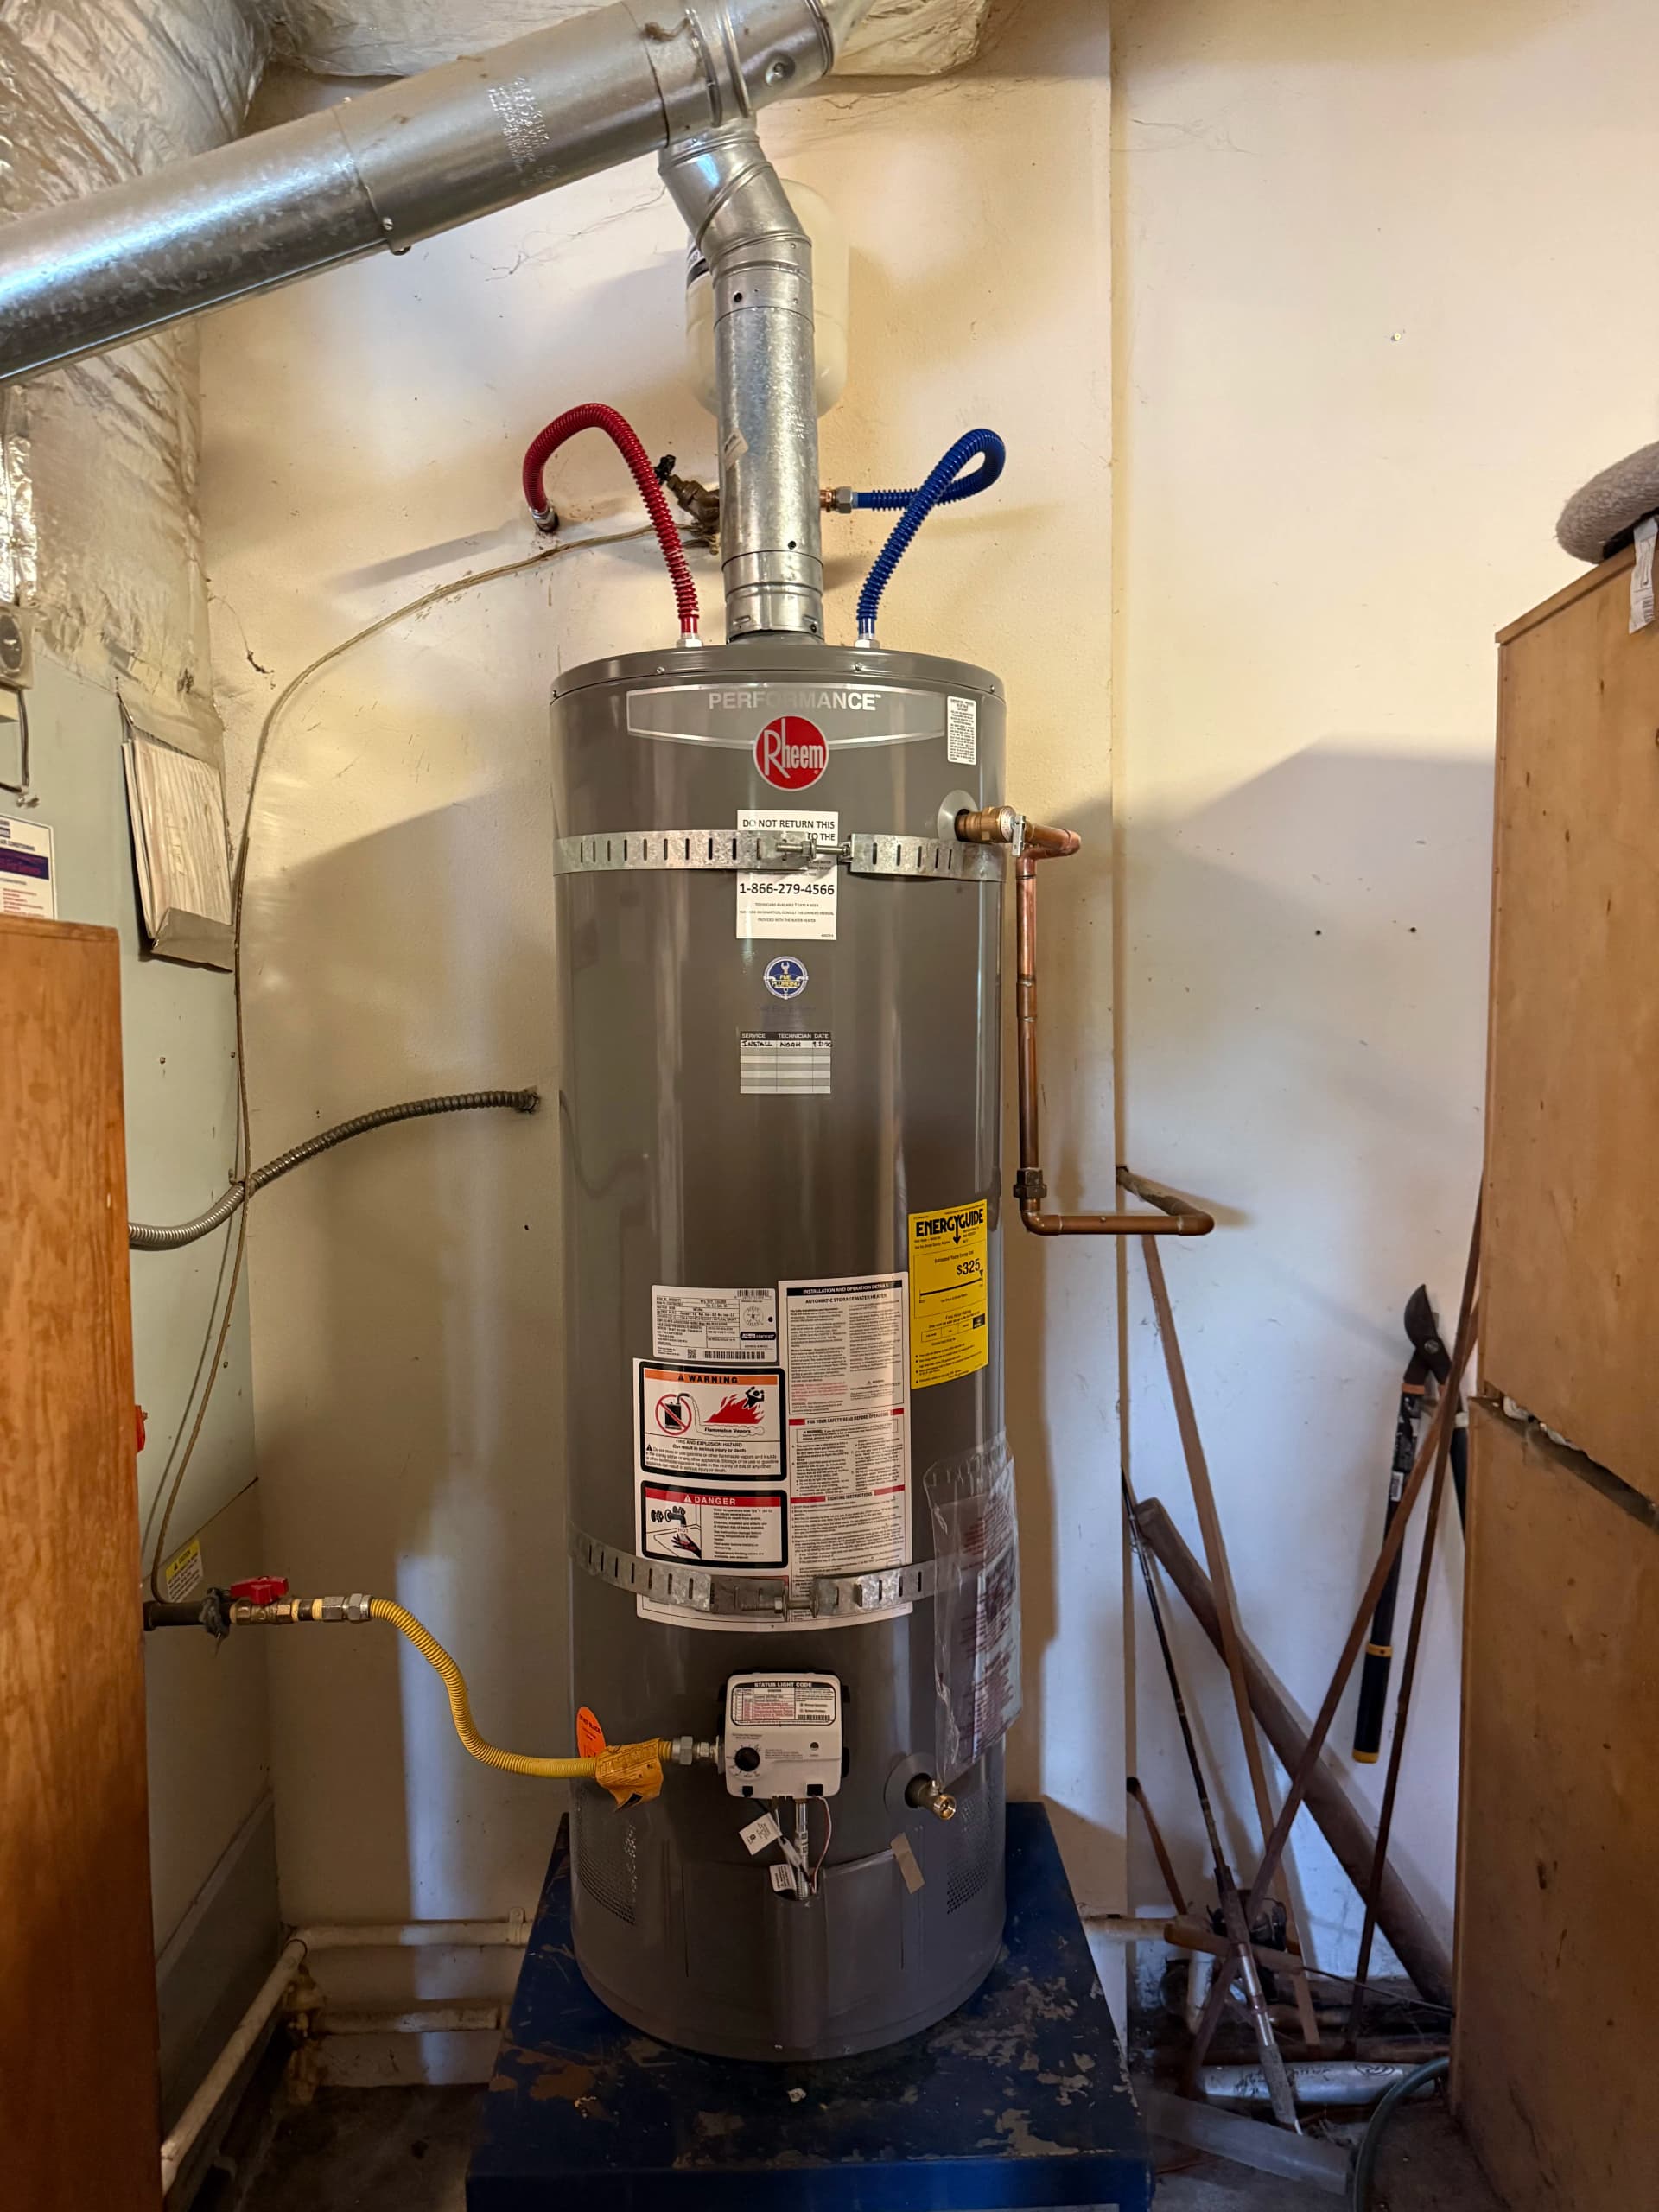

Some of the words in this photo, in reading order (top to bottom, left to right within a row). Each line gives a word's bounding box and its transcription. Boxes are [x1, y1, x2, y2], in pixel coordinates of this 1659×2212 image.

[709, 692, 876, 711] PERFORMANCE
[764, 717, 823, 779] Rheem
[742, 819, 756, 828] DO
[758, 819, 778, 828] NOT
[779, 819, 814, 829] RETURN
[816, 820, 835, 830] THIS
[819, 832, 836, 842] THE
[739, 882, 835, 895] 1-866-279-4566
[916, 1208, 984, 1237] ENERGYGUIDE
[956, 1257, 981, 1276] $325
[688, 1374, 738, 1384] WARNING
[694, 1495, 736, 1506] DANGER
